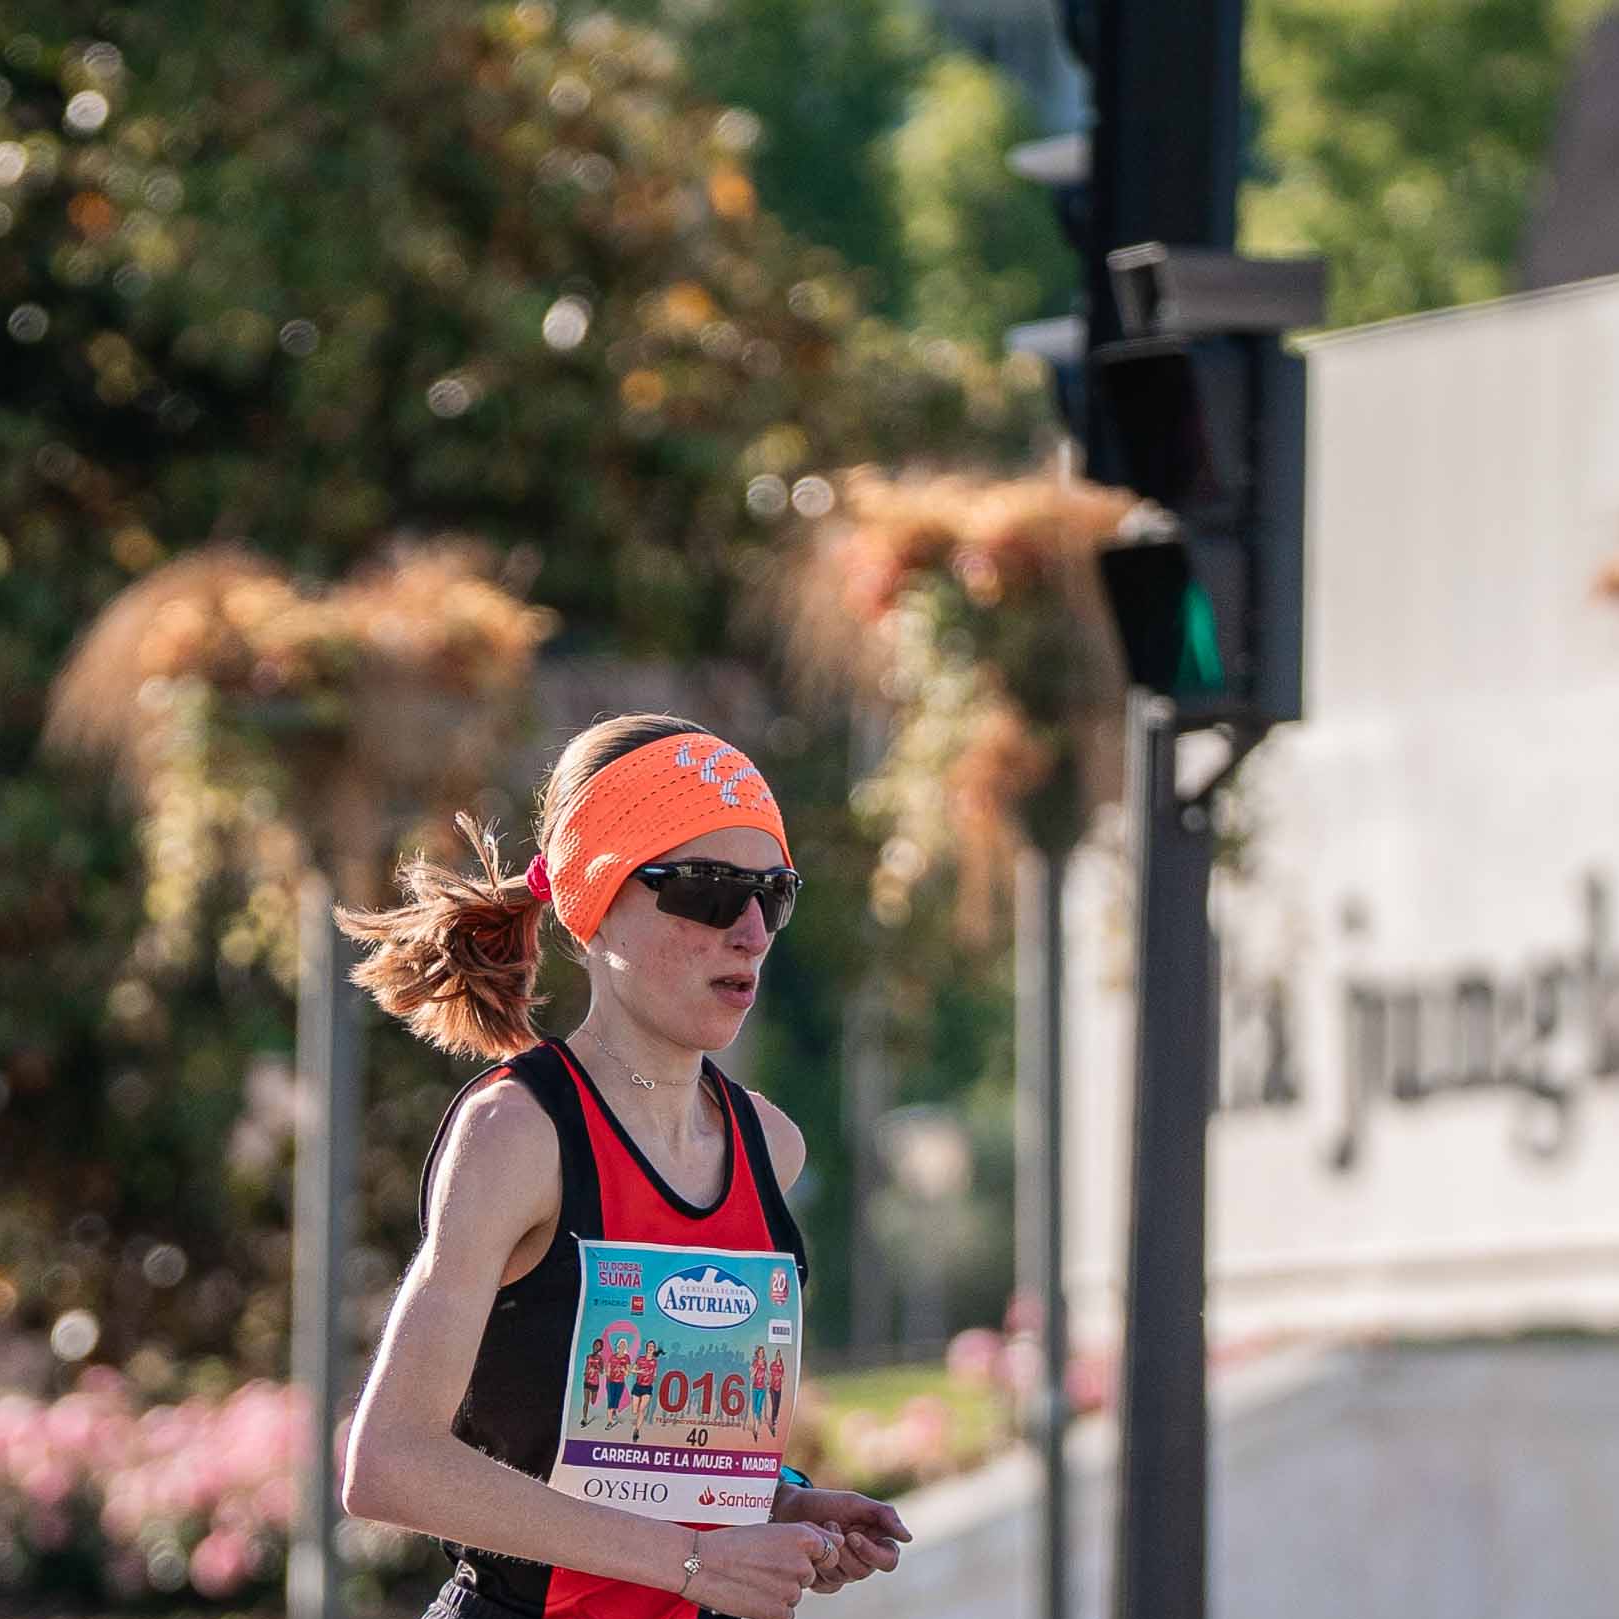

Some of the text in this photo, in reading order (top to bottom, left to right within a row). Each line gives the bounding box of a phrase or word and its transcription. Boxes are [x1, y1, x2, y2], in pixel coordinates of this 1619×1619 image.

[598, 1261, 609, 1270] TU
[599, 1271, 641, 1288] SUMA
[663, 1286, 751, 1314] ASTURIANA
[658, 1369, 746, 1417] 016
[686, 1427, 709, 1447] 40
[592, 1447, 778, 1472] CARRERA DE LA MUJER MADRID
[583, 1478, 668, 1503] OYSHO
